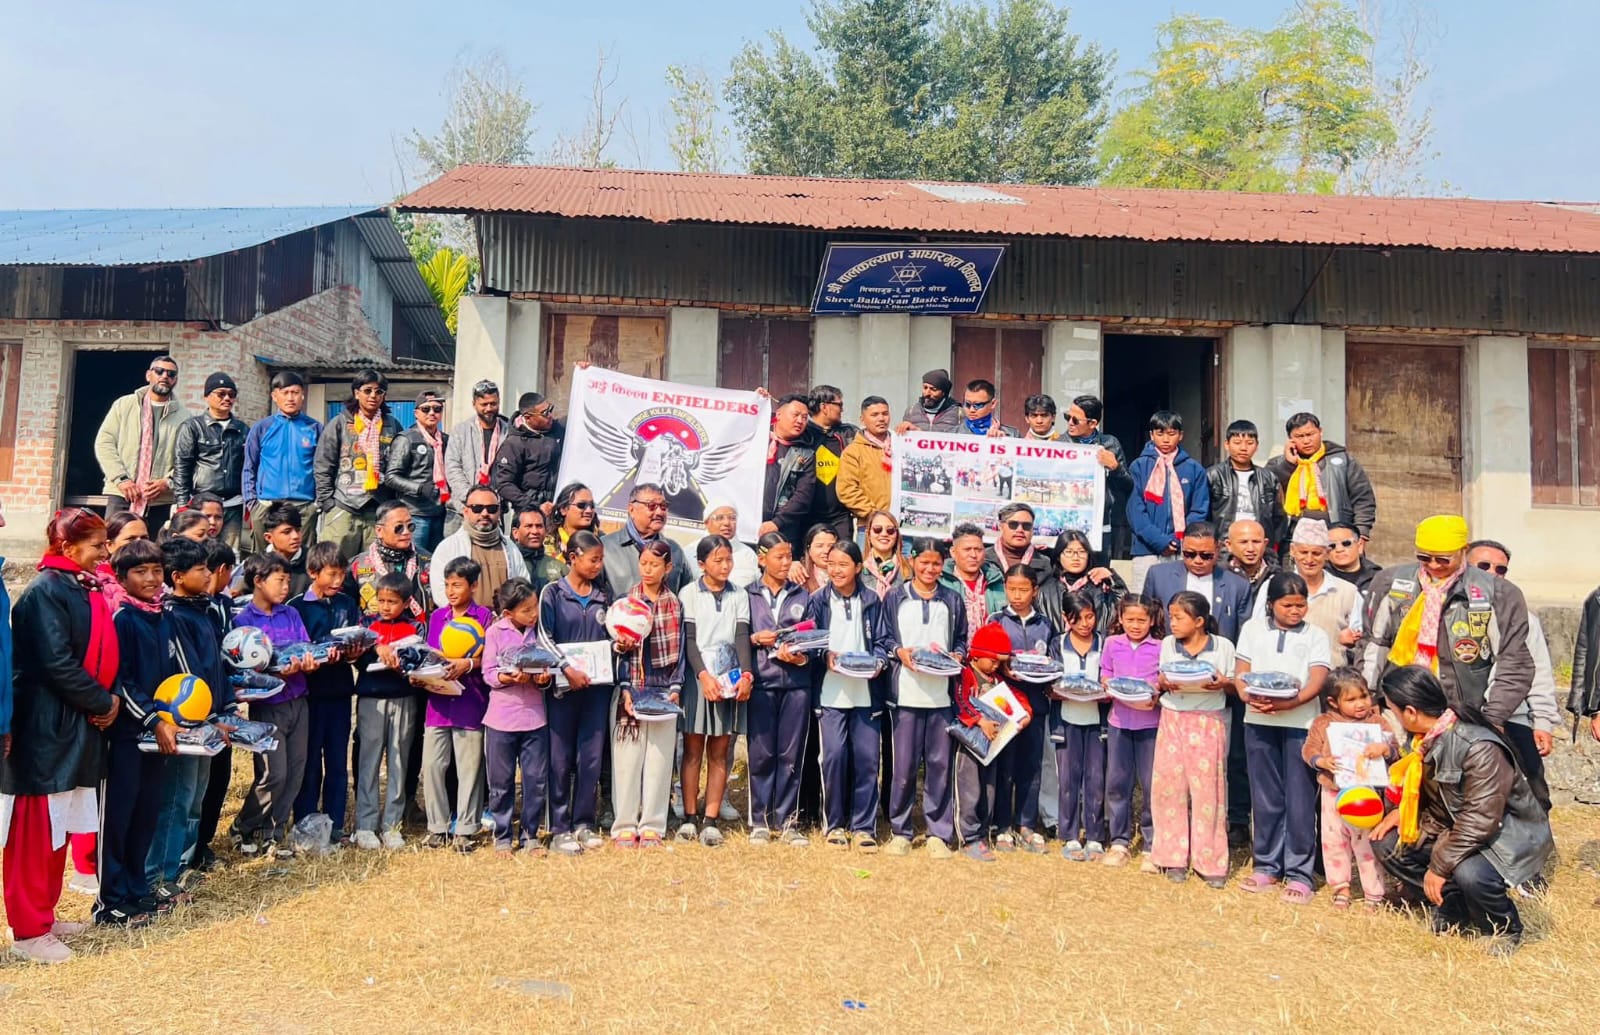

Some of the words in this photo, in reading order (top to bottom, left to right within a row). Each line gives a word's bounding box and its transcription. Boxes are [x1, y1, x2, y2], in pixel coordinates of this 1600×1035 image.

[824, 295, 854, 303] Shree
[857, 296, 909, 305] Balkalyan
[911, 295, 939, 304] Basic
[940, 295, 977, 303] School
[651, 391, 759, 416] ENFIELDERS
[649, 407, 672, 416] KILLA
[917, 439, 980, 453] GIVING
[990, 444, 1006, 455] IS
[1016, 446, 1078, 460] LIVING
